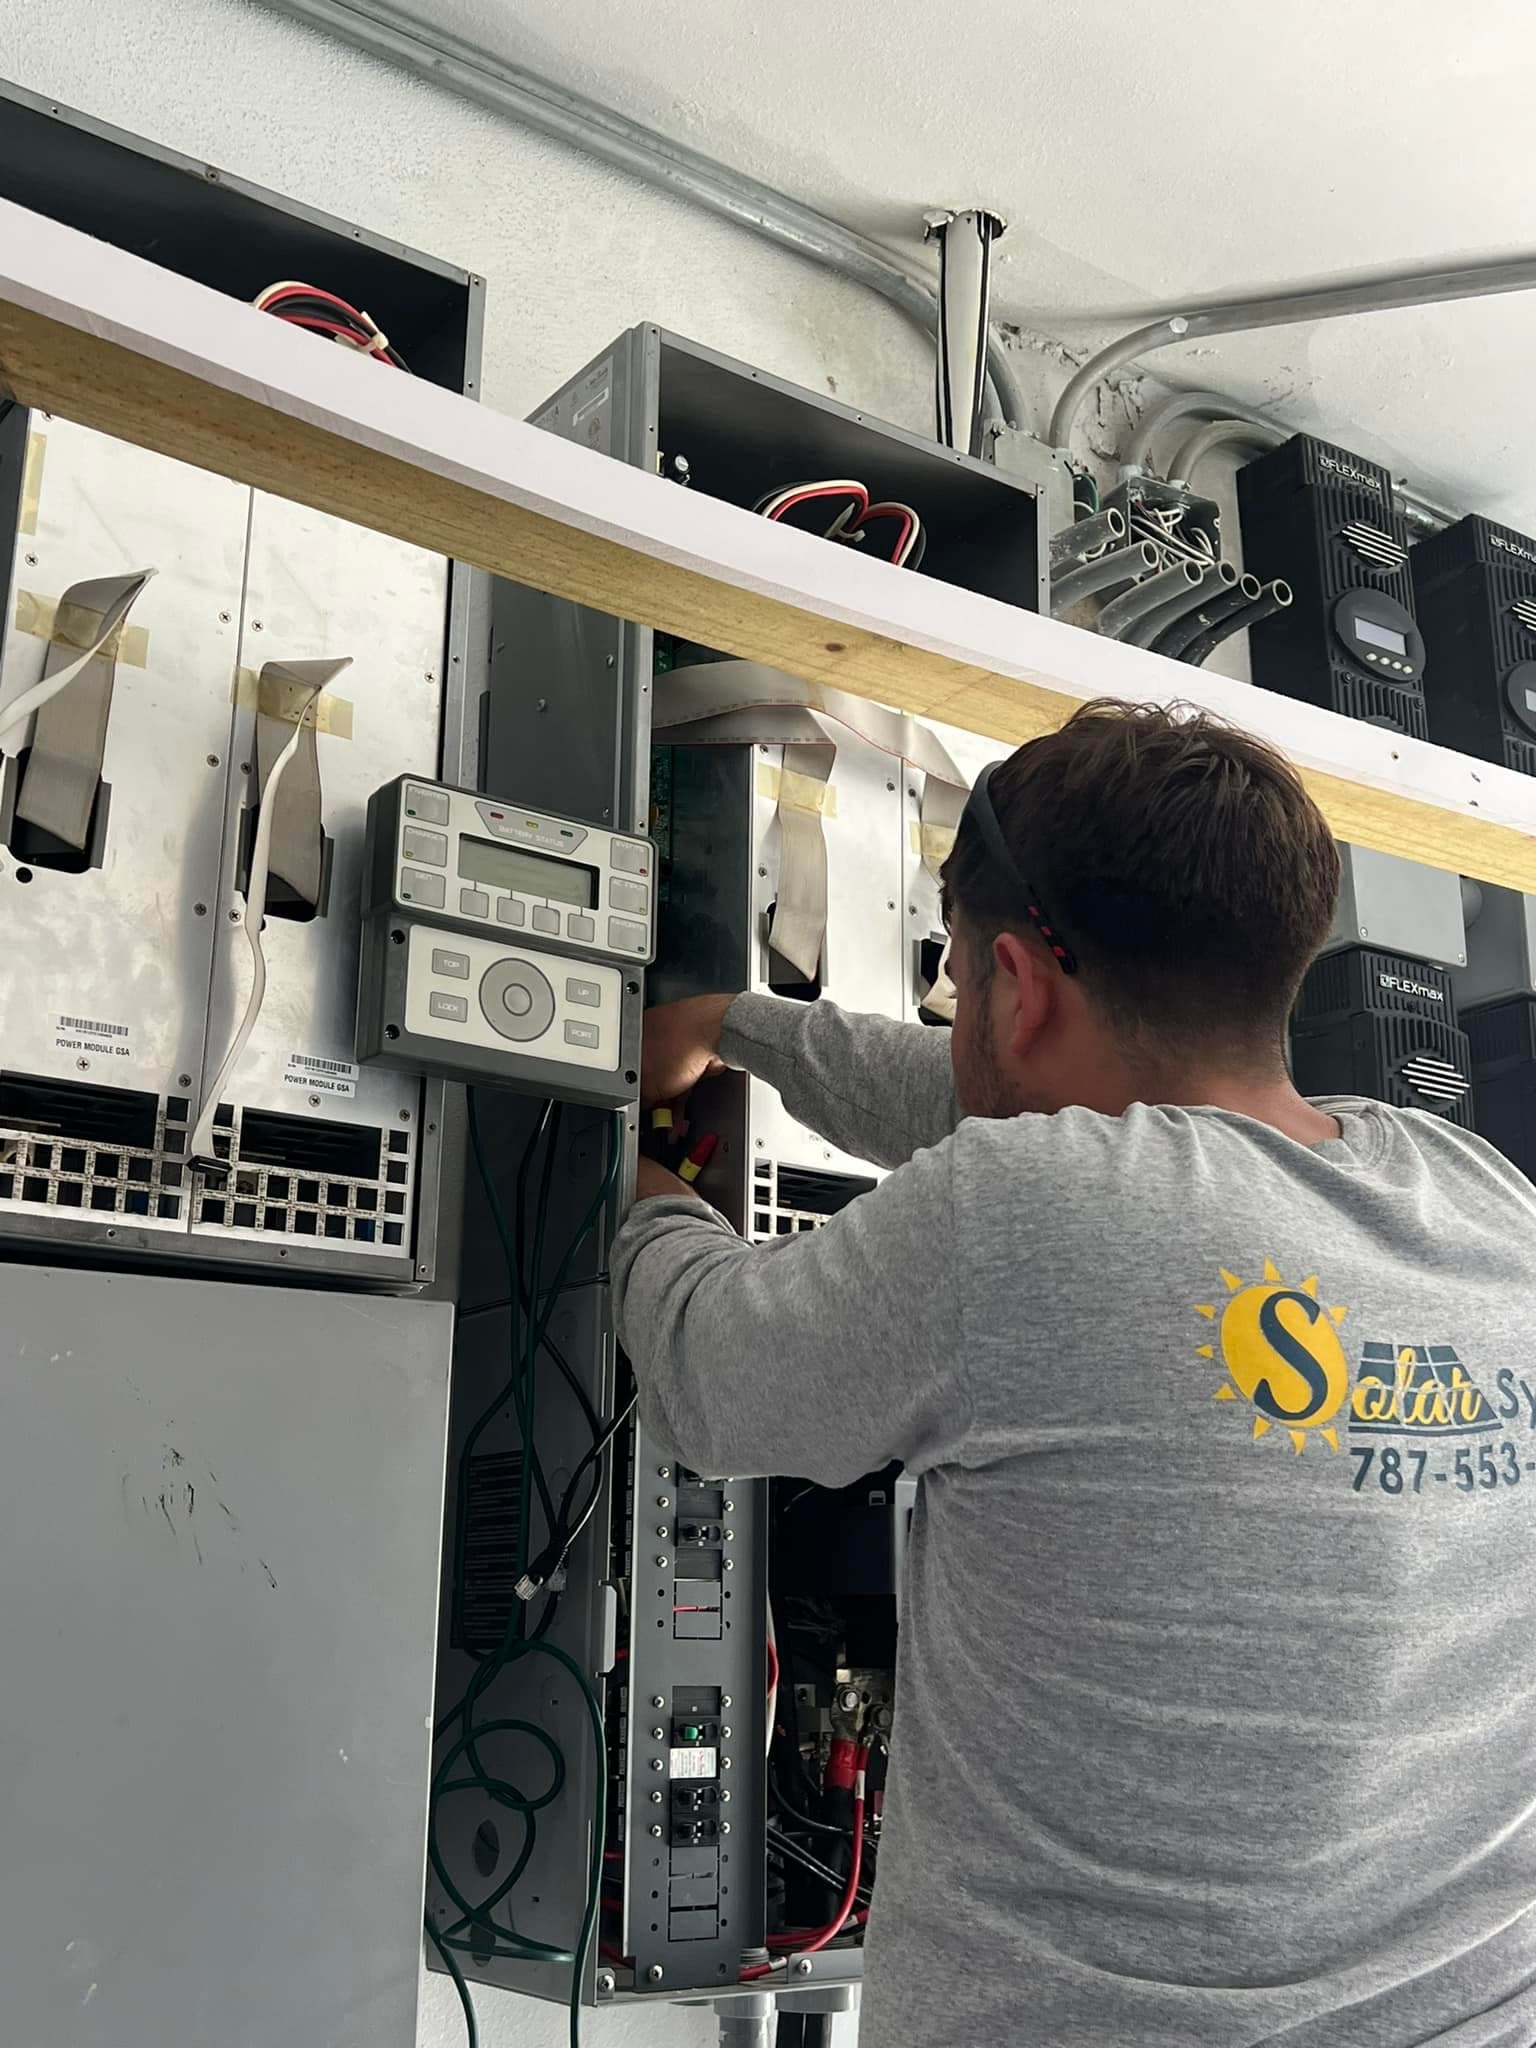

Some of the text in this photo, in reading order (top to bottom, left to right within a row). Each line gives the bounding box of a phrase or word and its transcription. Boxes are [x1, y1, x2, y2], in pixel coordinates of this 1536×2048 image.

[1328, 459, 1382, 490] FLEXmax
[1389, 976, 1444, 1001] FLEXmax
[437, 1002, 460, 1013] LOCK
[56, 1038, 82, 1050] POWER
[84, 1042, 114, 1054] MODULE
[284, 1073, 308, 1085] POWER
[309, 1078, 335, 1090] MODULE
